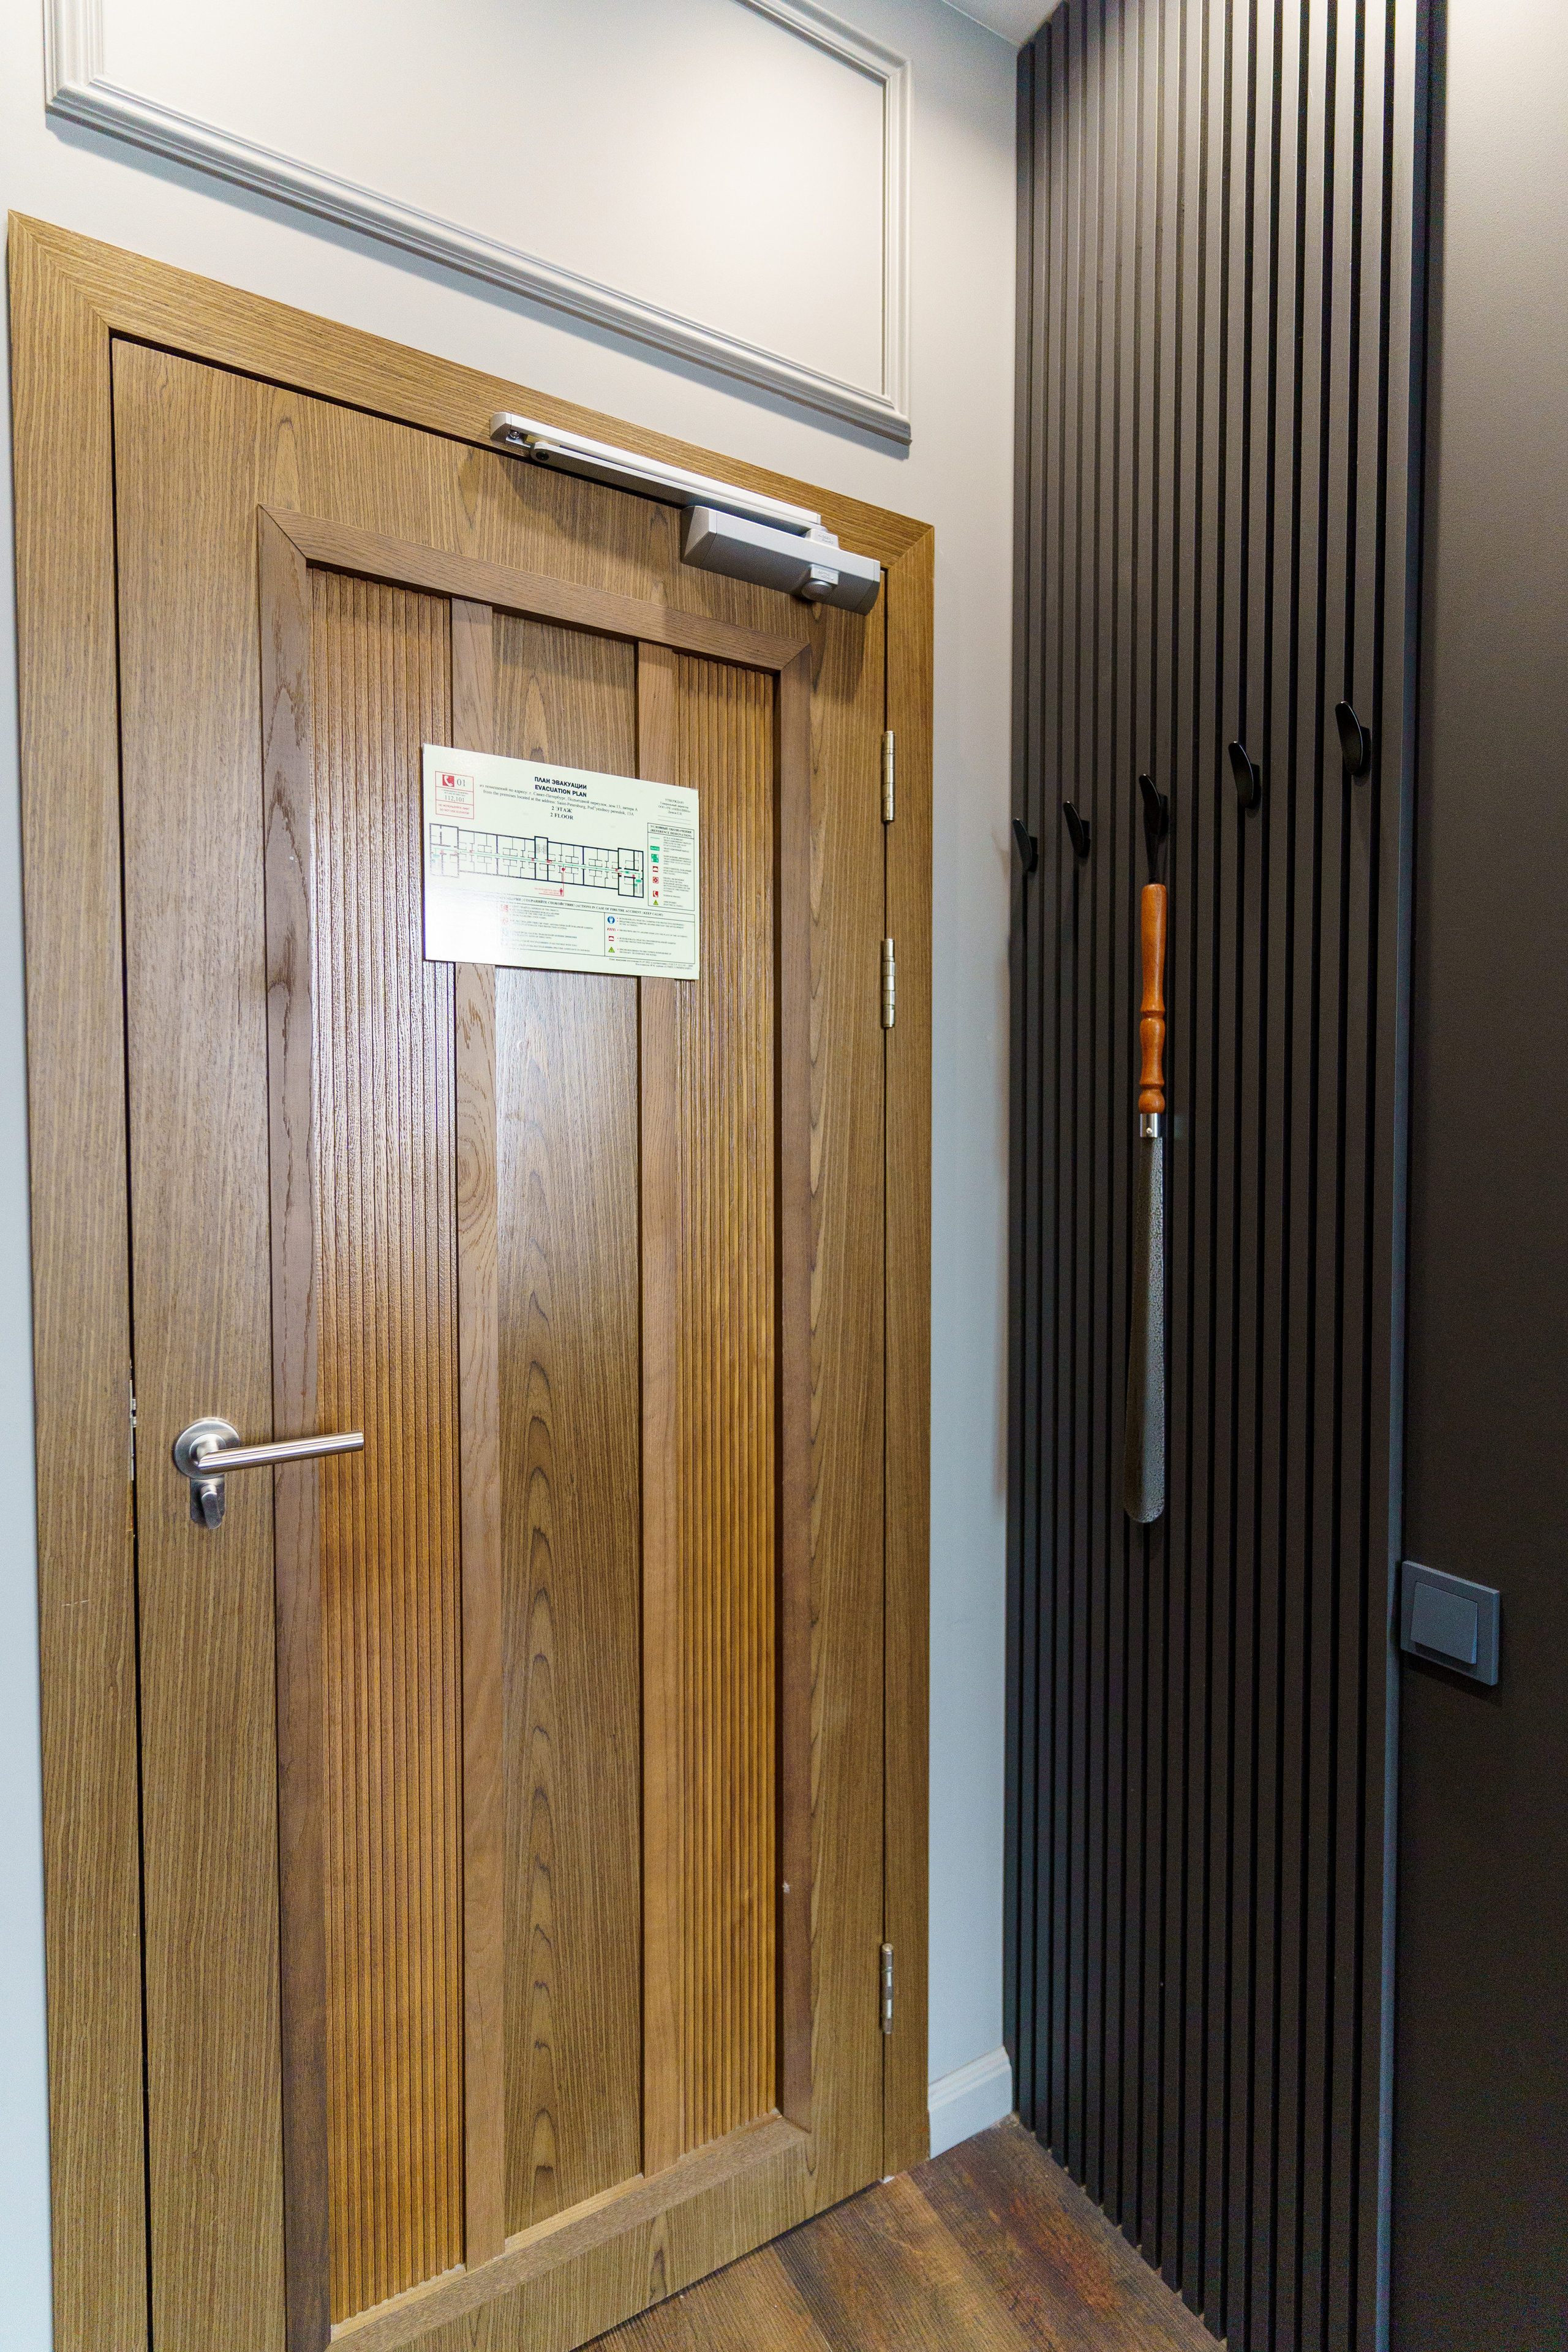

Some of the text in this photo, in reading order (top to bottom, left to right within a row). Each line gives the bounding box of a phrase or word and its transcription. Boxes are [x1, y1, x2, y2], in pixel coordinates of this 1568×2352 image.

[535, 785, 570, 794] EVACUATION
[551, 779, 587, 790] ЭВАКУАЦИИ
[533, 791, 567, 801] Санкт-Петербург,
